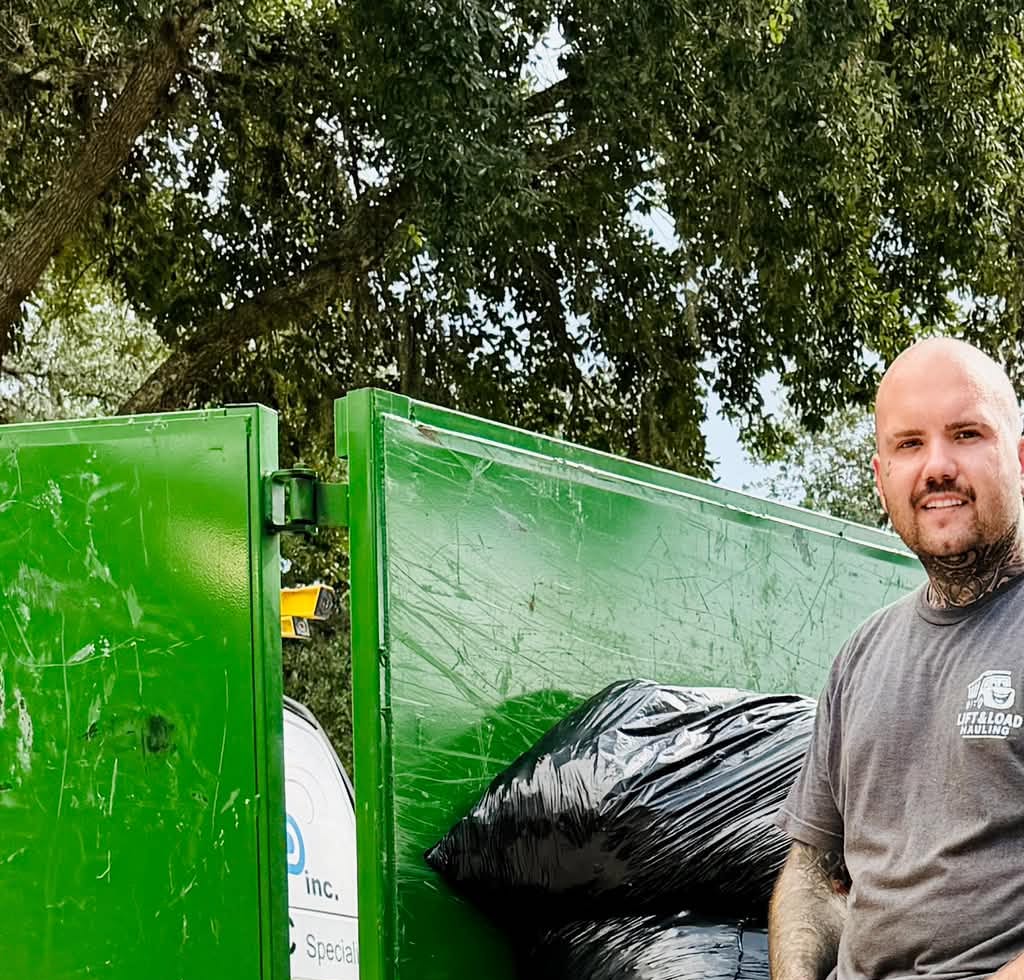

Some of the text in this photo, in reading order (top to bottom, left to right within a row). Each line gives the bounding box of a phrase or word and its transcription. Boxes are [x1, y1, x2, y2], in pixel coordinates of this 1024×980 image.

[960, 724, 1010, 736] HAULING
[304, 869, 339, 901] inc.
[305, 933, 359, 966] Special
